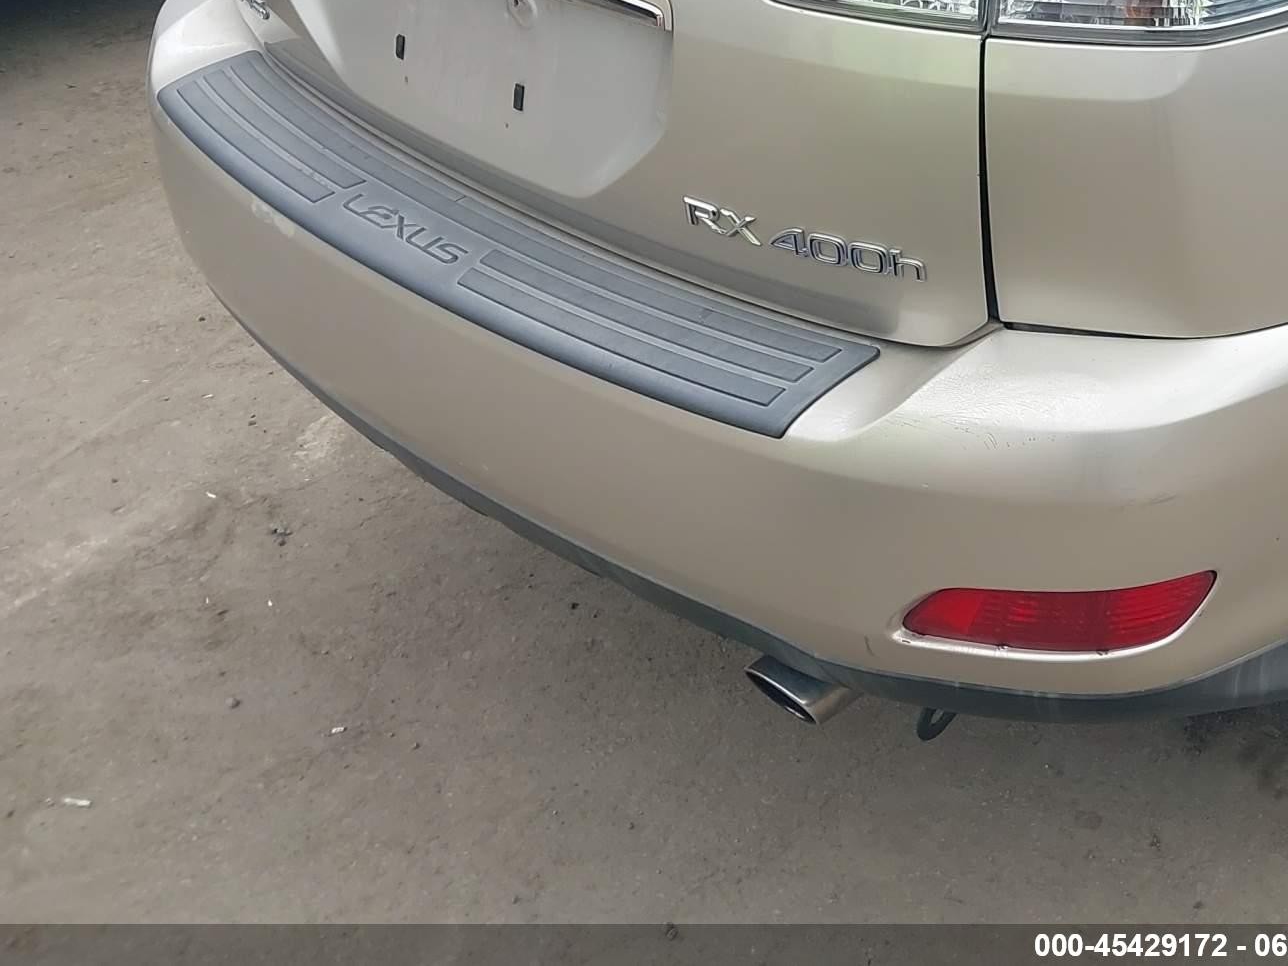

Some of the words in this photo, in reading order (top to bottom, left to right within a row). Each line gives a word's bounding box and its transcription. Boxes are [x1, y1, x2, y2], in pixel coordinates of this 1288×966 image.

[342, 192, 470, 265] LEXUS
[682, 194, 763, 247] RX
[768, 226, 927, 283] 400h
